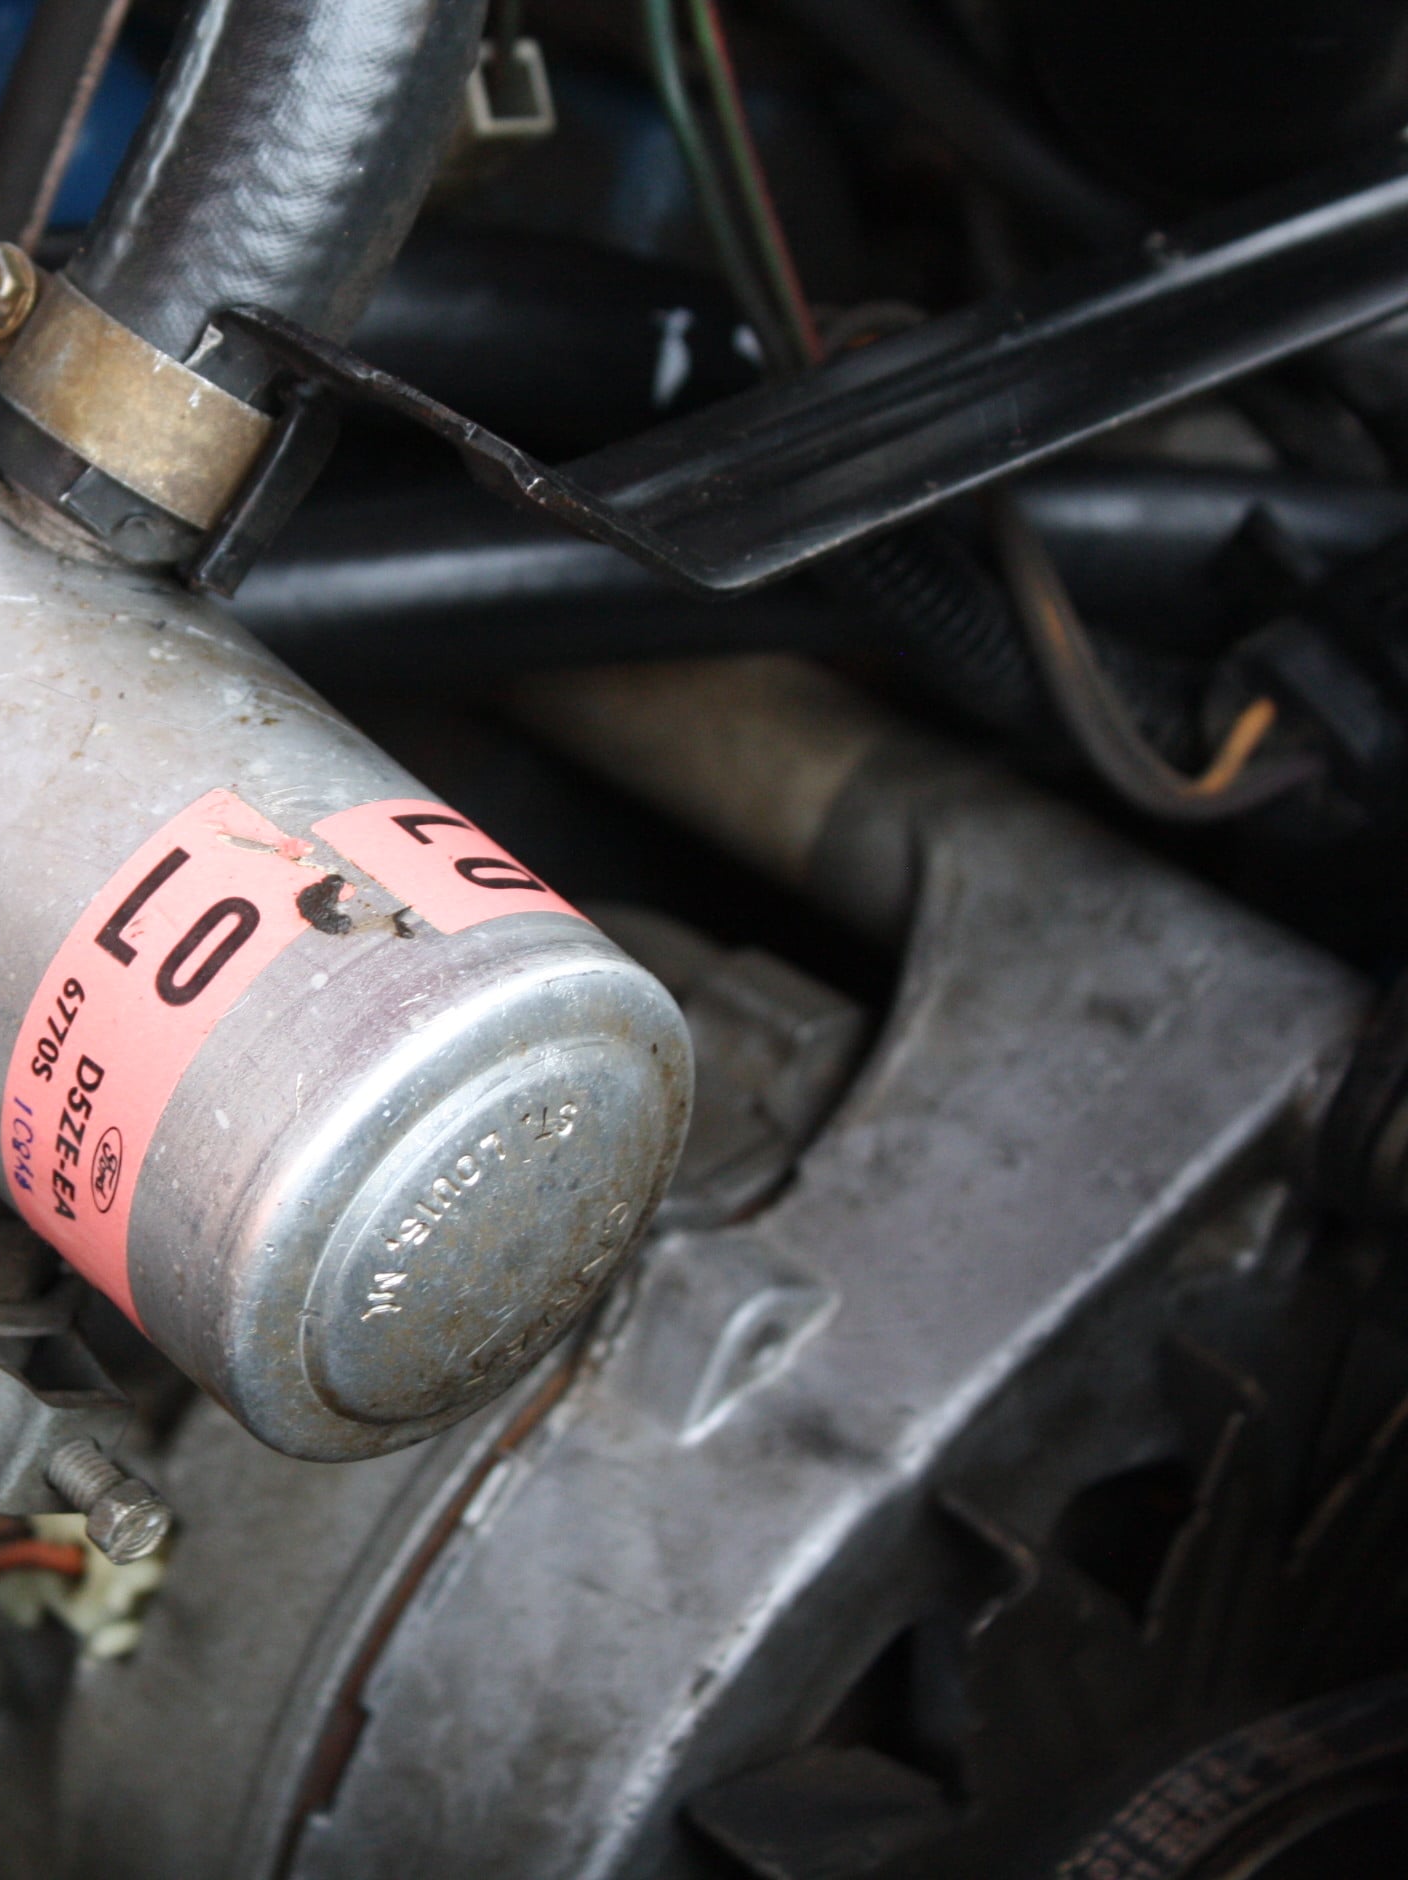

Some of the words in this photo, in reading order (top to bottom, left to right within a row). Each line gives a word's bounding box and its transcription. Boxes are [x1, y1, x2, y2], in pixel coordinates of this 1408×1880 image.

[93, 846, 261, 1007] LO
[31, 977, 86, 1083] 6770S
[52, 1054, 105, 1221] D5ZE-EA
